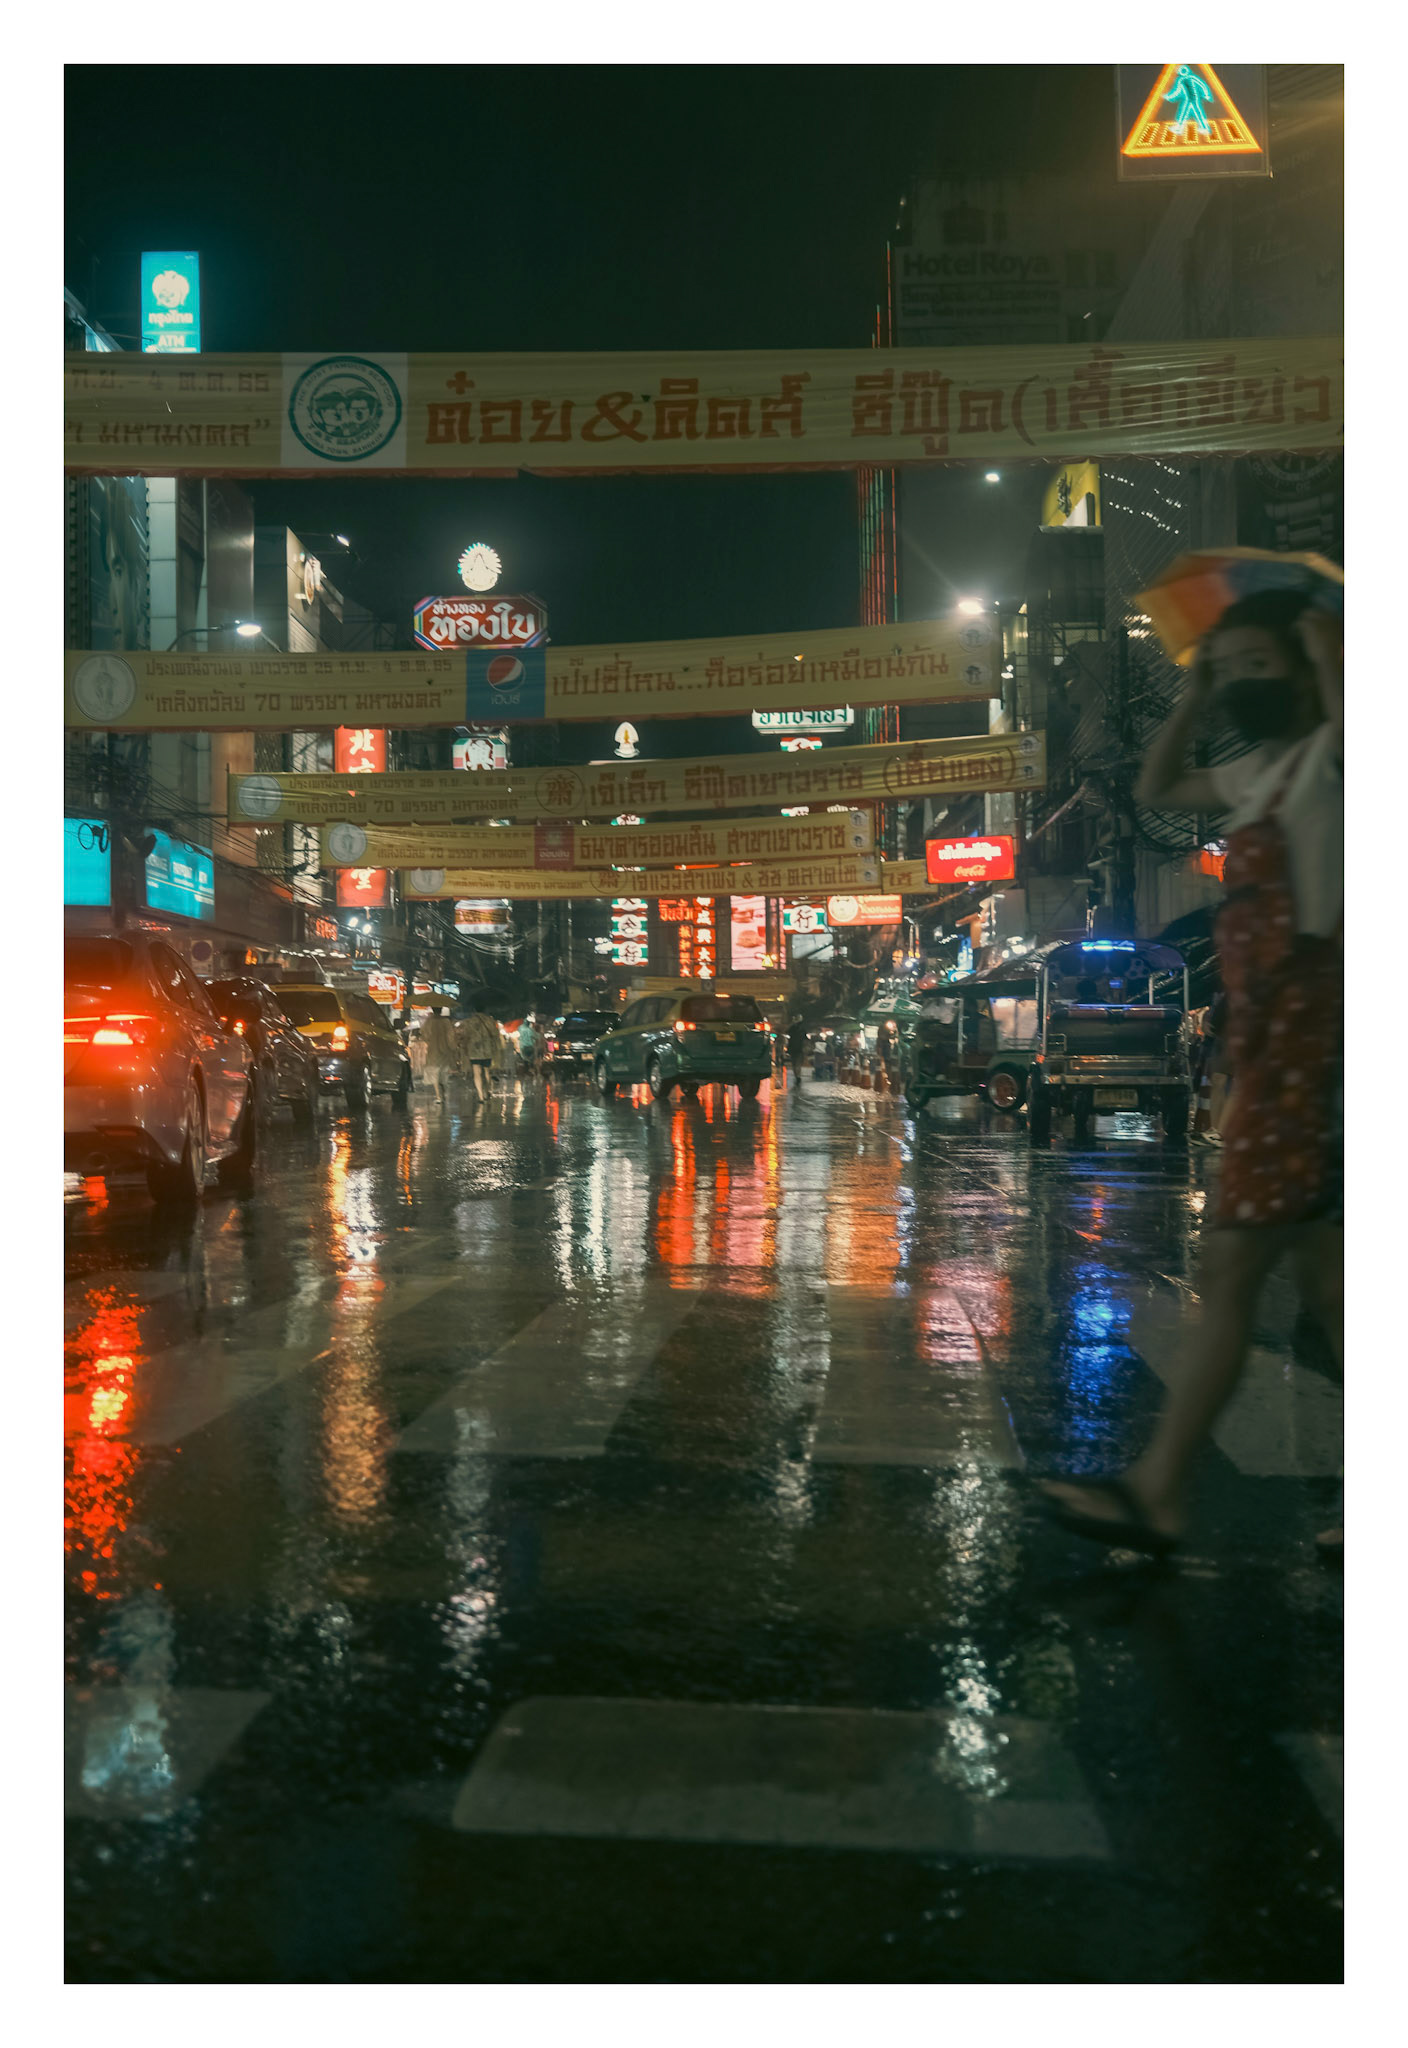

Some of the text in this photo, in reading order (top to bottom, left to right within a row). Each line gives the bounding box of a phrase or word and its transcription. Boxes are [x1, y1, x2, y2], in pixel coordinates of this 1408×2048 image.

[903, 253, 976, 276] Hotel
[157, 334, 185, 347] ATM
[428, 601, 536, 642] ทองใบ
[254, 692, 281, 712] 70
[290, 693, 348, 713] พรรษา
[374, 799, 395, 813] 70
[794, 909, 813, 928] 行
